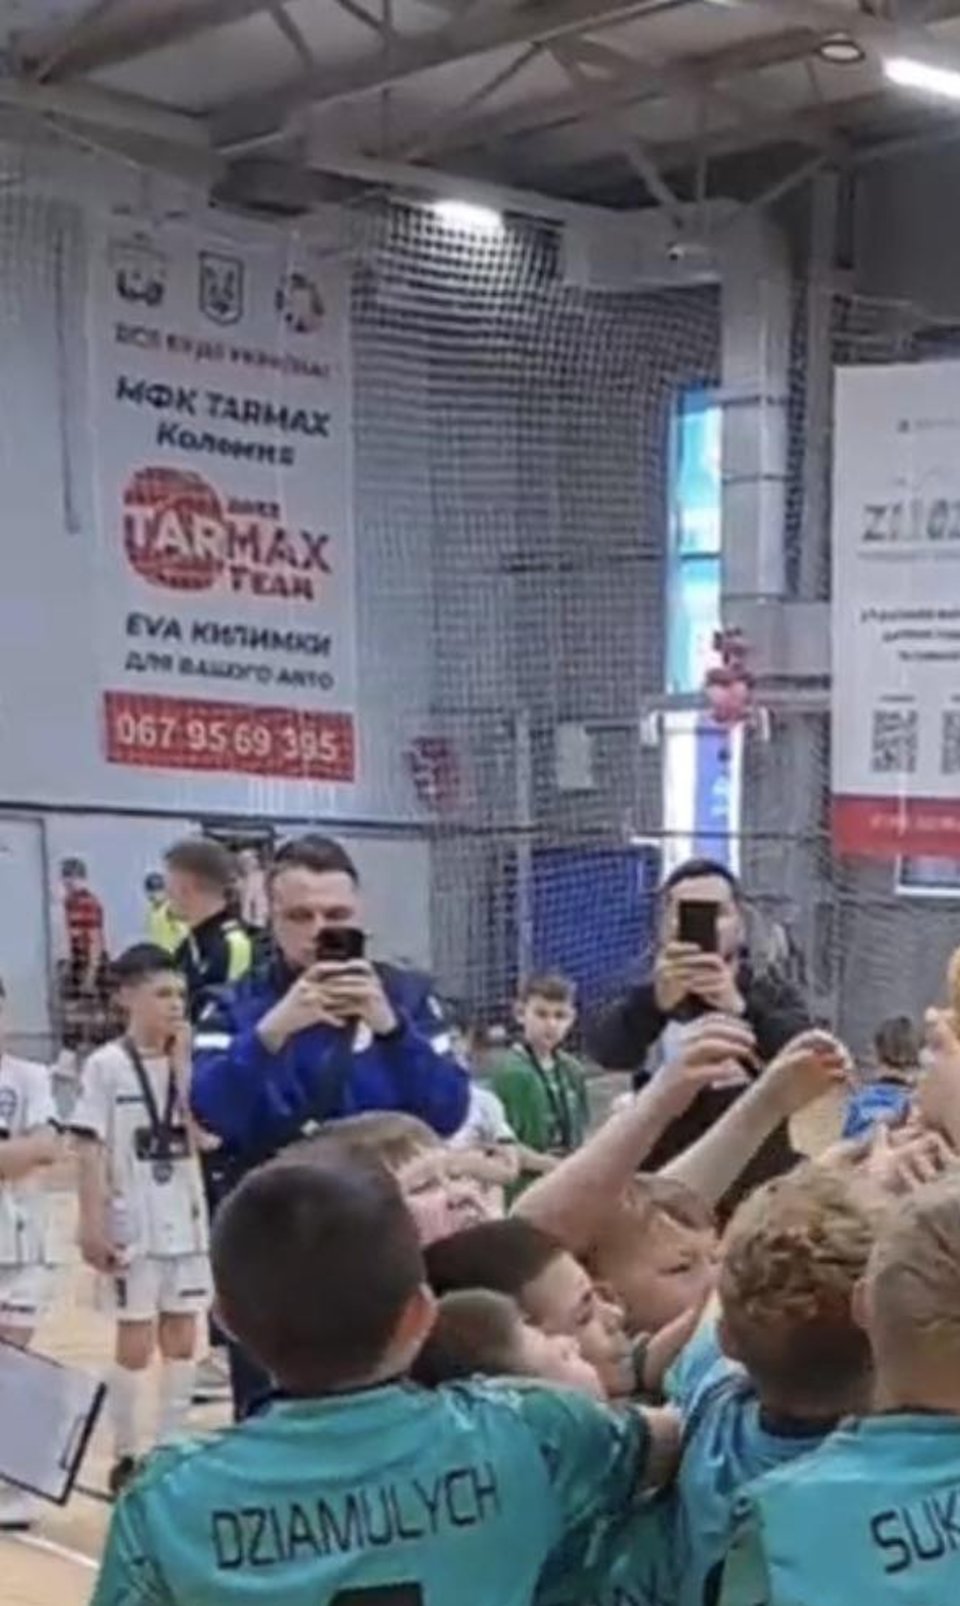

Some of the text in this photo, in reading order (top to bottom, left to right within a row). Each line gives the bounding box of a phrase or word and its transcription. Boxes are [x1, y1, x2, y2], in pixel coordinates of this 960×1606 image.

[126, 612, 183, 642] EVA
[117, 711, 177, 748] 067
[234, 722, 272, 758] 69
[212, 1460, 502, 1570] DZIAMULYCH
